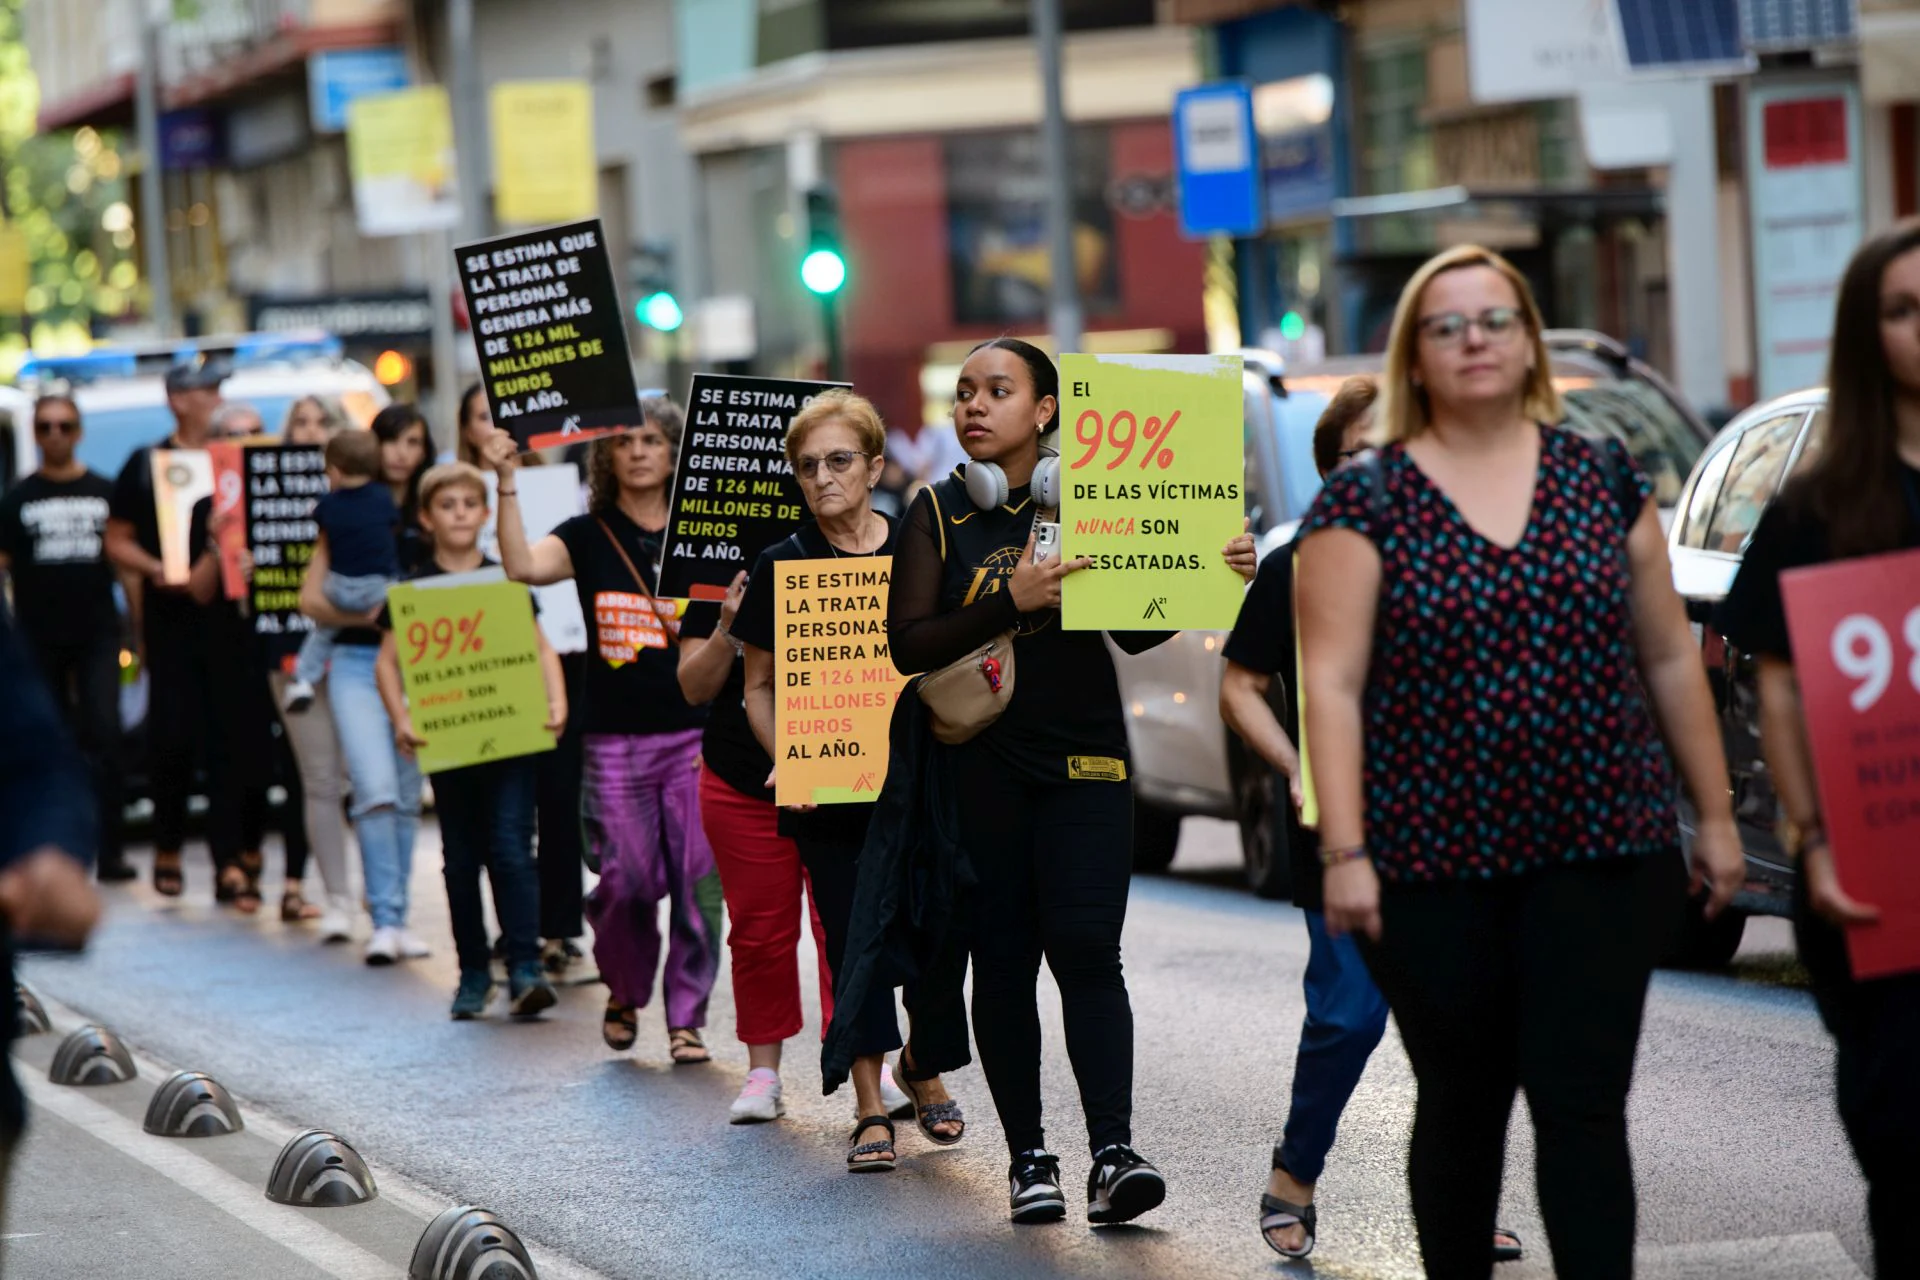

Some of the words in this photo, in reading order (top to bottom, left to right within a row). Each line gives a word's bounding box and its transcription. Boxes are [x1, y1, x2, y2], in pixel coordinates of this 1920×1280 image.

[466, 254, 490, 273] SE
[492, 240, 558, 268] ESTIMA
[560, 231, 597, 252] QUE
[470, 275, 496, 294] LA
[497, 263, 553, 289] TRATA
[555, 257, 581, 275] DE
[475, 281, 569, 315] PERSONAS
[480, 307, 551, 335] GENERA
[552, 297, 592, 320] MÁS
[485, 338, 509, 356] DE
[512, 331, 545, 349] 126
[547, 323, 580, 341] MIL
[489, 345, 576, 377] MILLONES
[579, 339, 603, 357] DE
[494, 372, 553, 398] EUROS
[500, 401, 523, 418] AL
[526, 391, 569, 413] AÑO.
[700, 388, 723, 404] SE
[728, 390, 796, 409] ESTIMA
[696, 411, 719, 426] LA
[726, 412, 783, 430] TRATA
[692, 432, 787, 453] PERSONAS
[1070, 409, 1182, 471] 99%
[250, 452, 278, 474] SE
[688, 454, 761, 474] GENERA
[250, 475, 279, 496] LA
[283, 474, 331, 495] TRAT
[684, 476, 709, 492] DE
[715, 479, 747, 494] 126
[752, 481, 784, 497] MIL
[1074, 484, 1097, 500] DE
[1105, 484, 1142, 500] LAS
[1148, 480, 1239, 500] VÍCTIMAS
[680, 498, 772, 518] MILLONES
[777, 504, 801, 520] DE
[252, 520, 320, 542] GENER
[677, 520, 738, 538] EUROS
[1075, 517, 1135, 536] NUNCA
[1141, 519, 1180, 535] SON
[253, 544, 281, 566] DE
[672, 542, 696, 558] AL
[701, 541, 745, 561] AÑO.
[785, 575, 809, 590] SE
[817, 571, 891, 589] ESTIMA
[785, 599, 810, 614] LA
[817, 595, 880, 613] TRATA
[255, 612, 284, 634] AL
[406, 609, 485, 666] 99%
[785, 645, 866, 663] GENERA
[414, 671, 432, 686] DE
[436, 666, 465, 682] LAS
[786, 671, 811, 687] DE
[820, 669, 854, 686] 126
[862, 667, 896, 683] MIL
[786, 692, 887, 711] MILLONES
[786, 718, 852, 735] EUROS
[786, 744, 812, 760] AL
[819, 739, 866, 758] AÑO.
